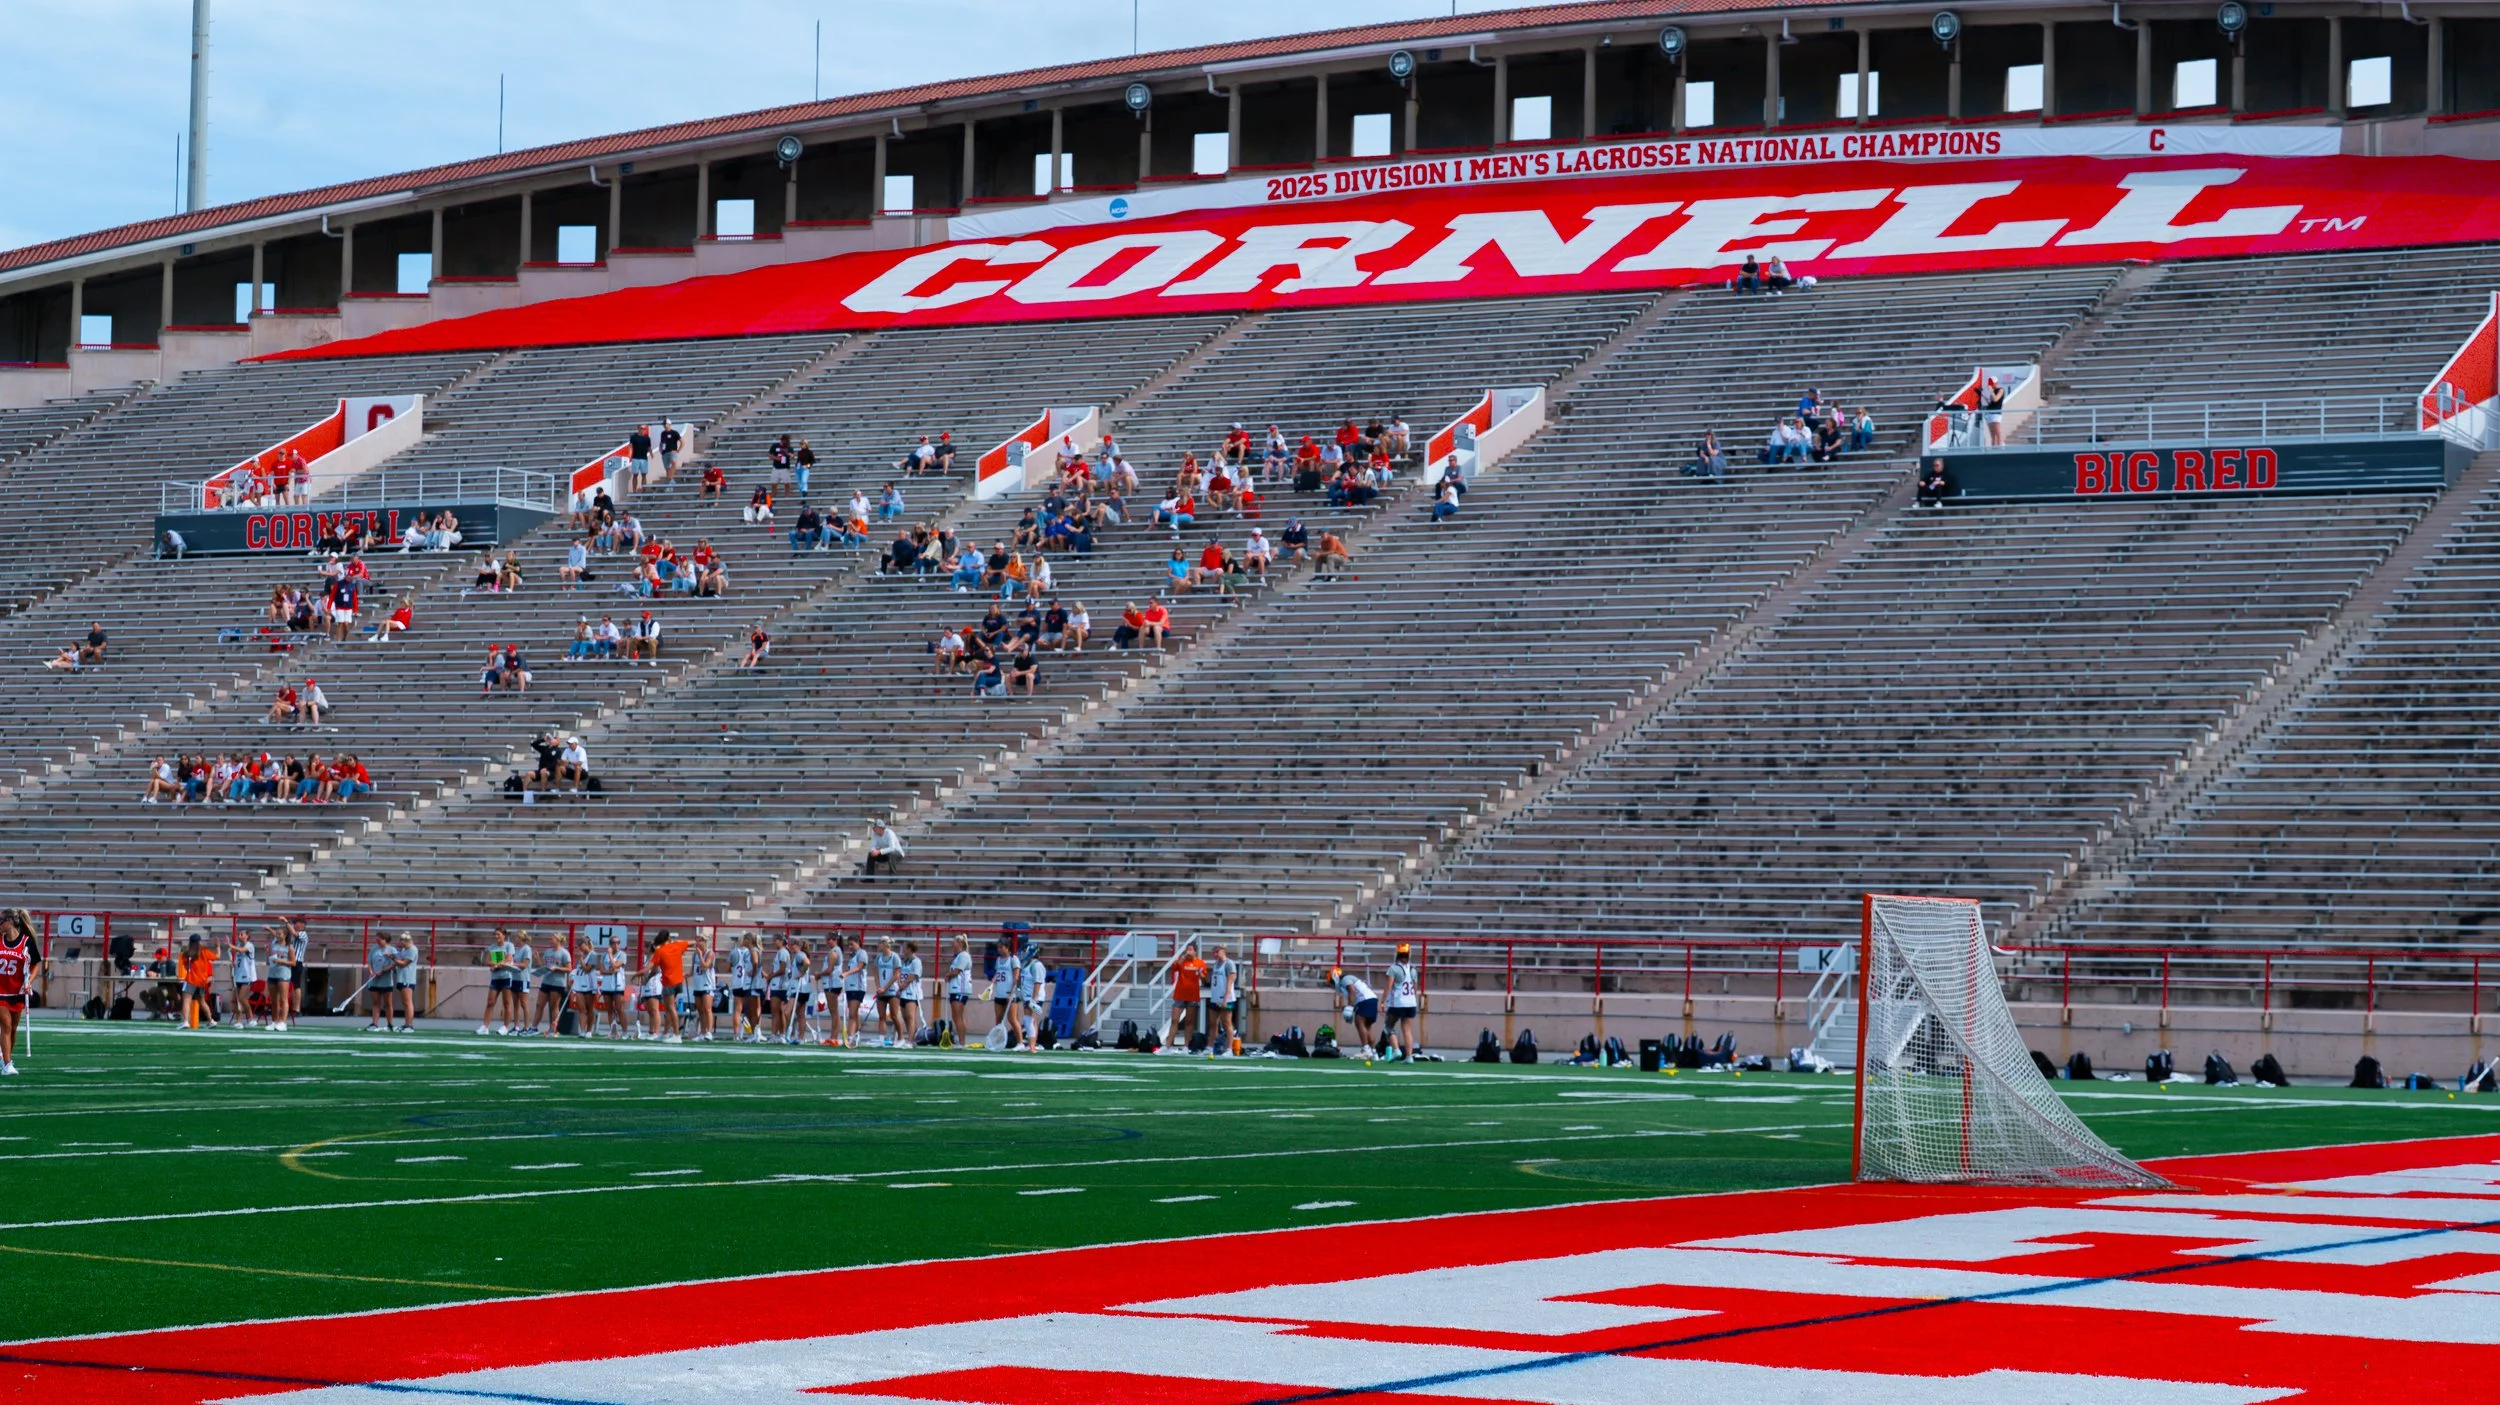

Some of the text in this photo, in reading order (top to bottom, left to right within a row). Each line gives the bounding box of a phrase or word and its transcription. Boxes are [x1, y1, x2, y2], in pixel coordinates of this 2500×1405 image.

[2150, 129, 2165, 150] C
[1267, 131, 2001, 201] 2025 DIVISION I MEN'S LACROSSE NATIONAL CHAMPIONS
[841, 168, 2368, 313] CORNELL TM
[2074, 448, 2278, 494] BIG RED
[71, 917, 83, 935] G
[599, 927, 613, 945] H
[0, 958, 17, 975] 25
[1818, 949, 1834, 970] K
